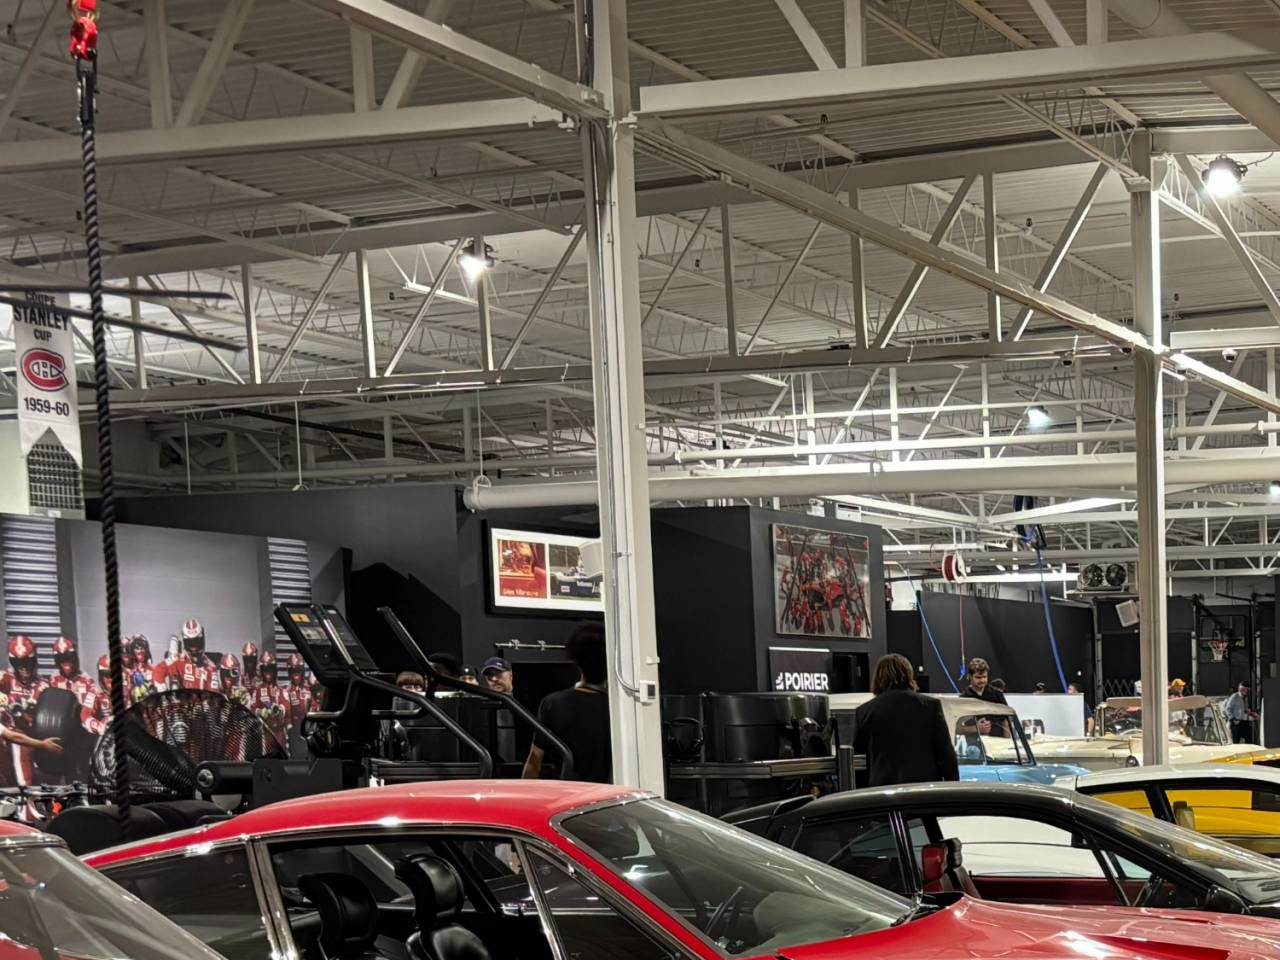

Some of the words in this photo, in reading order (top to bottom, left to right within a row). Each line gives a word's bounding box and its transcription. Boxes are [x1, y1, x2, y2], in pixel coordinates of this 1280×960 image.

[14, 304, 69, 331] STANLEY
[34, 328, 52, 342] CUP
[24, 397, 70, 416] 1959-60
[785, 671, 829, 690] POIRIER
